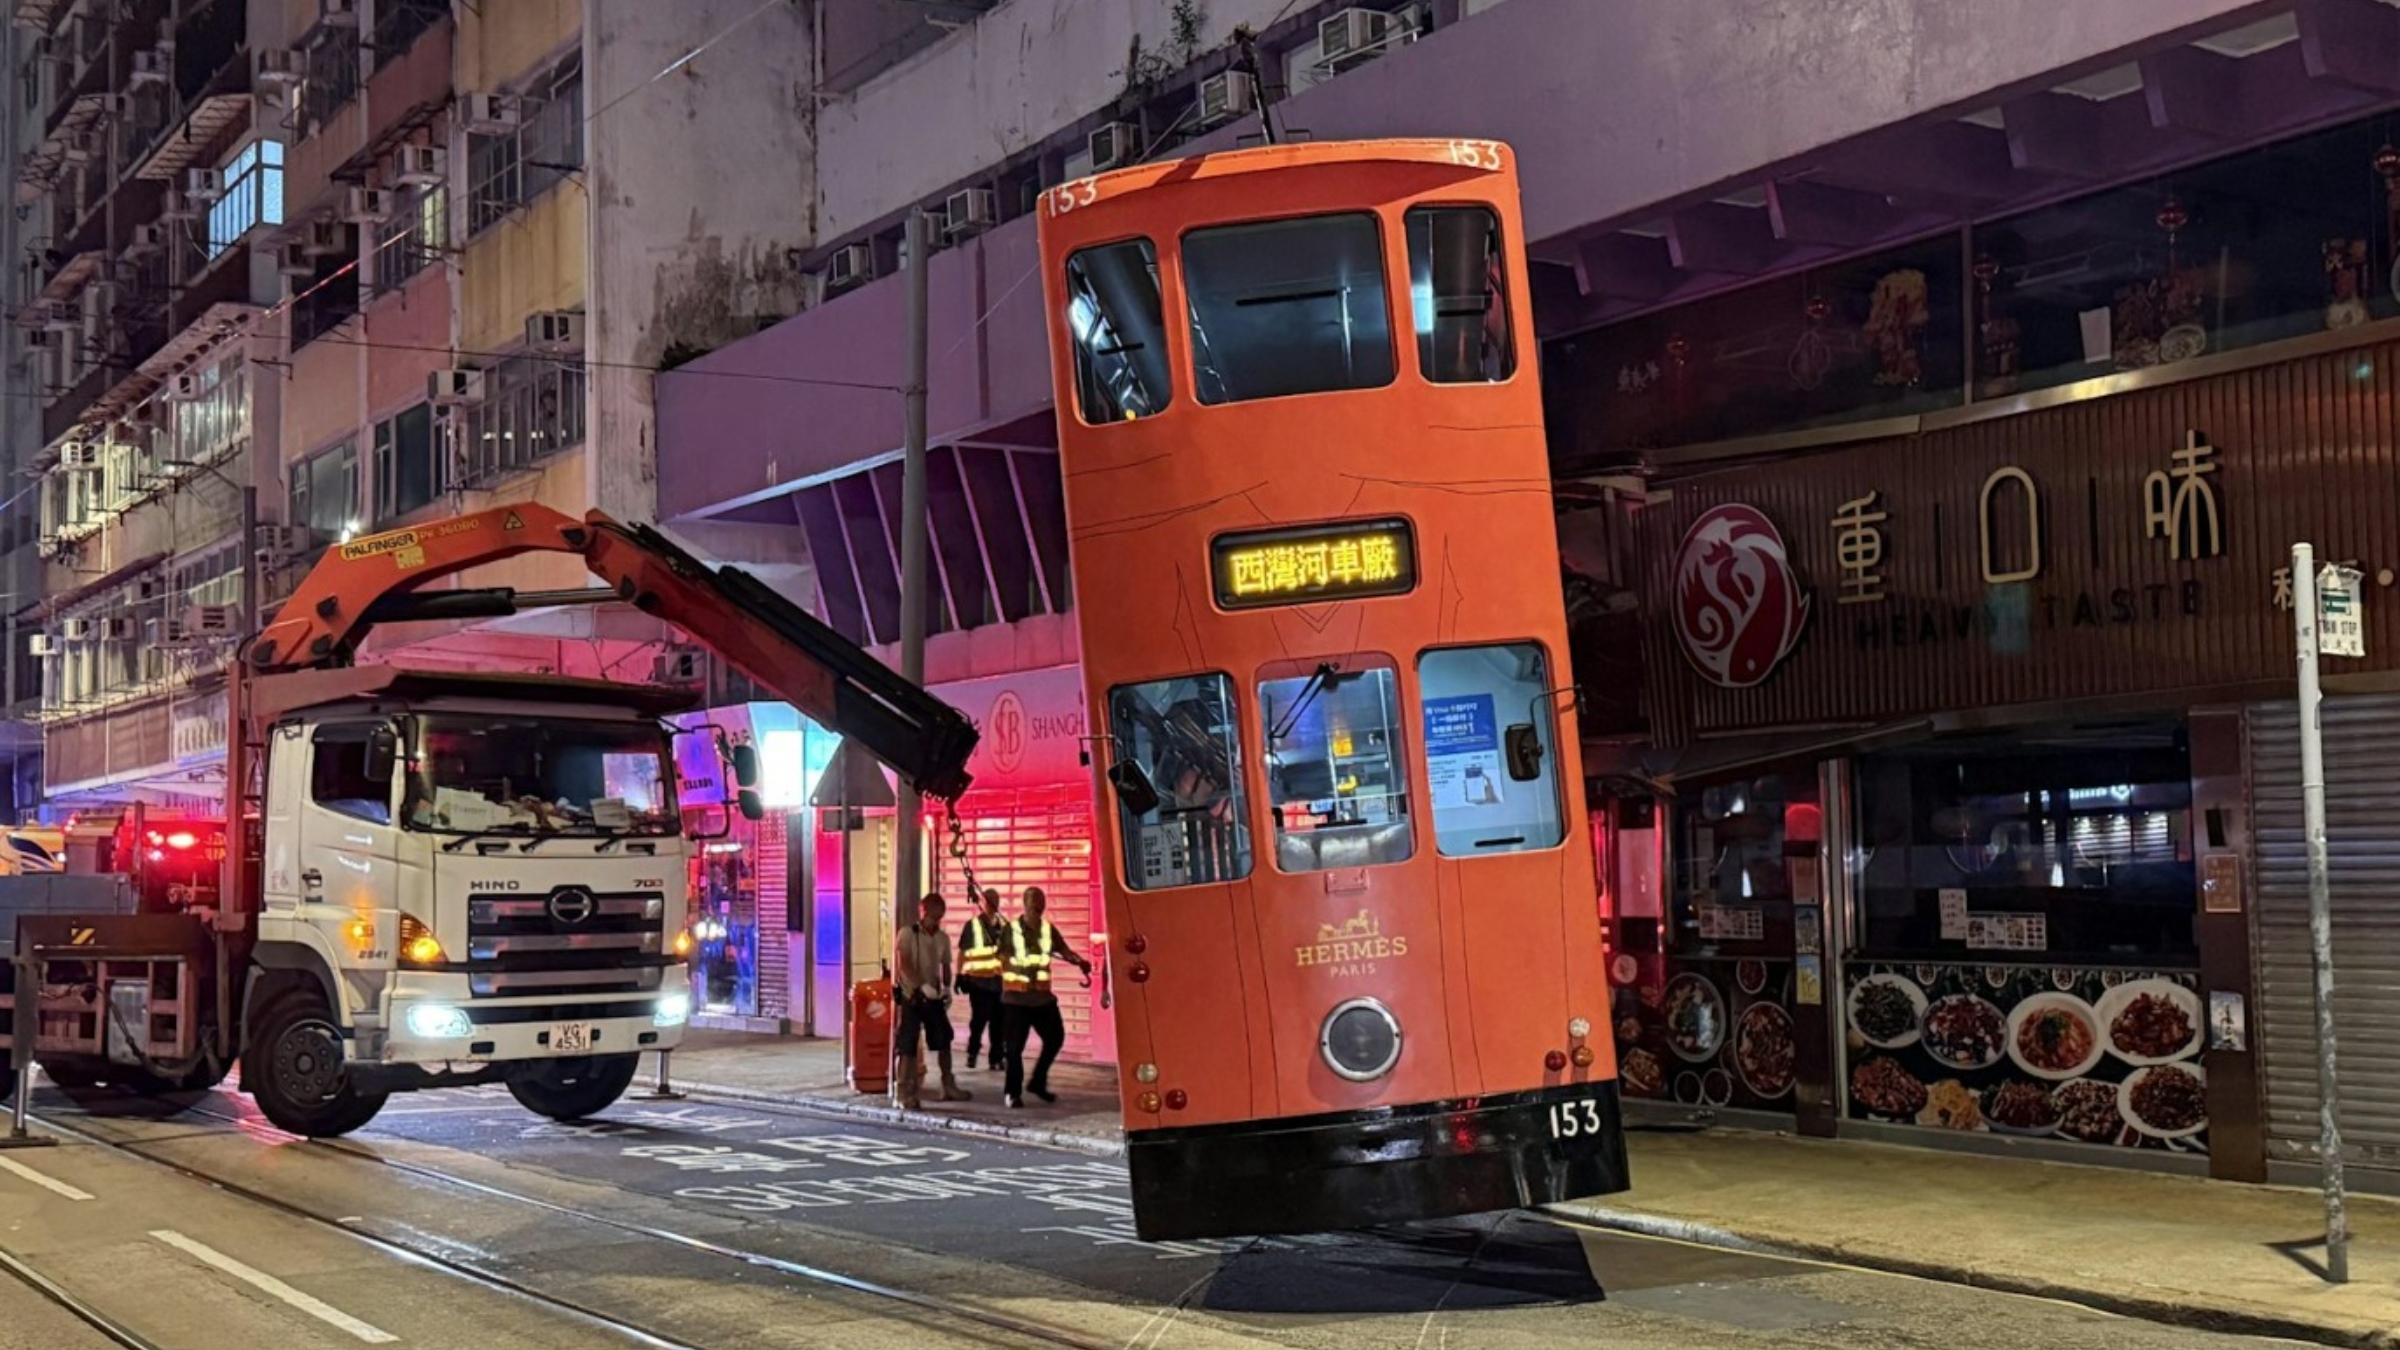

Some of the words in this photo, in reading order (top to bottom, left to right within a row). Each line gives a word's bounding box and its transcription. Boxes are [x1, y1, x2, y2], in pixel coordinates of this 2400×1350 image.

[1449, 138, 1501, 171] 153
[1049, 178, 1098, 217] 153
[345, 532, 415, 559] PALFINGER
[1230, 535, 1399, 597] 西灣河車廠
[2040, 579, 2202, 630] TASTE
[470, 880, 521, 891] HINO
[1296, 935, 1406, 966] HERMÈS
[1330, 963, 1376, 978] PARIS
[555, 1035, 586, 1050] 4531
[563, 1023, 580, 1036] VG
[1550, 1099, 1601, 1138] 153
[673, 1162, 1131, 1211] ASSENGERS
